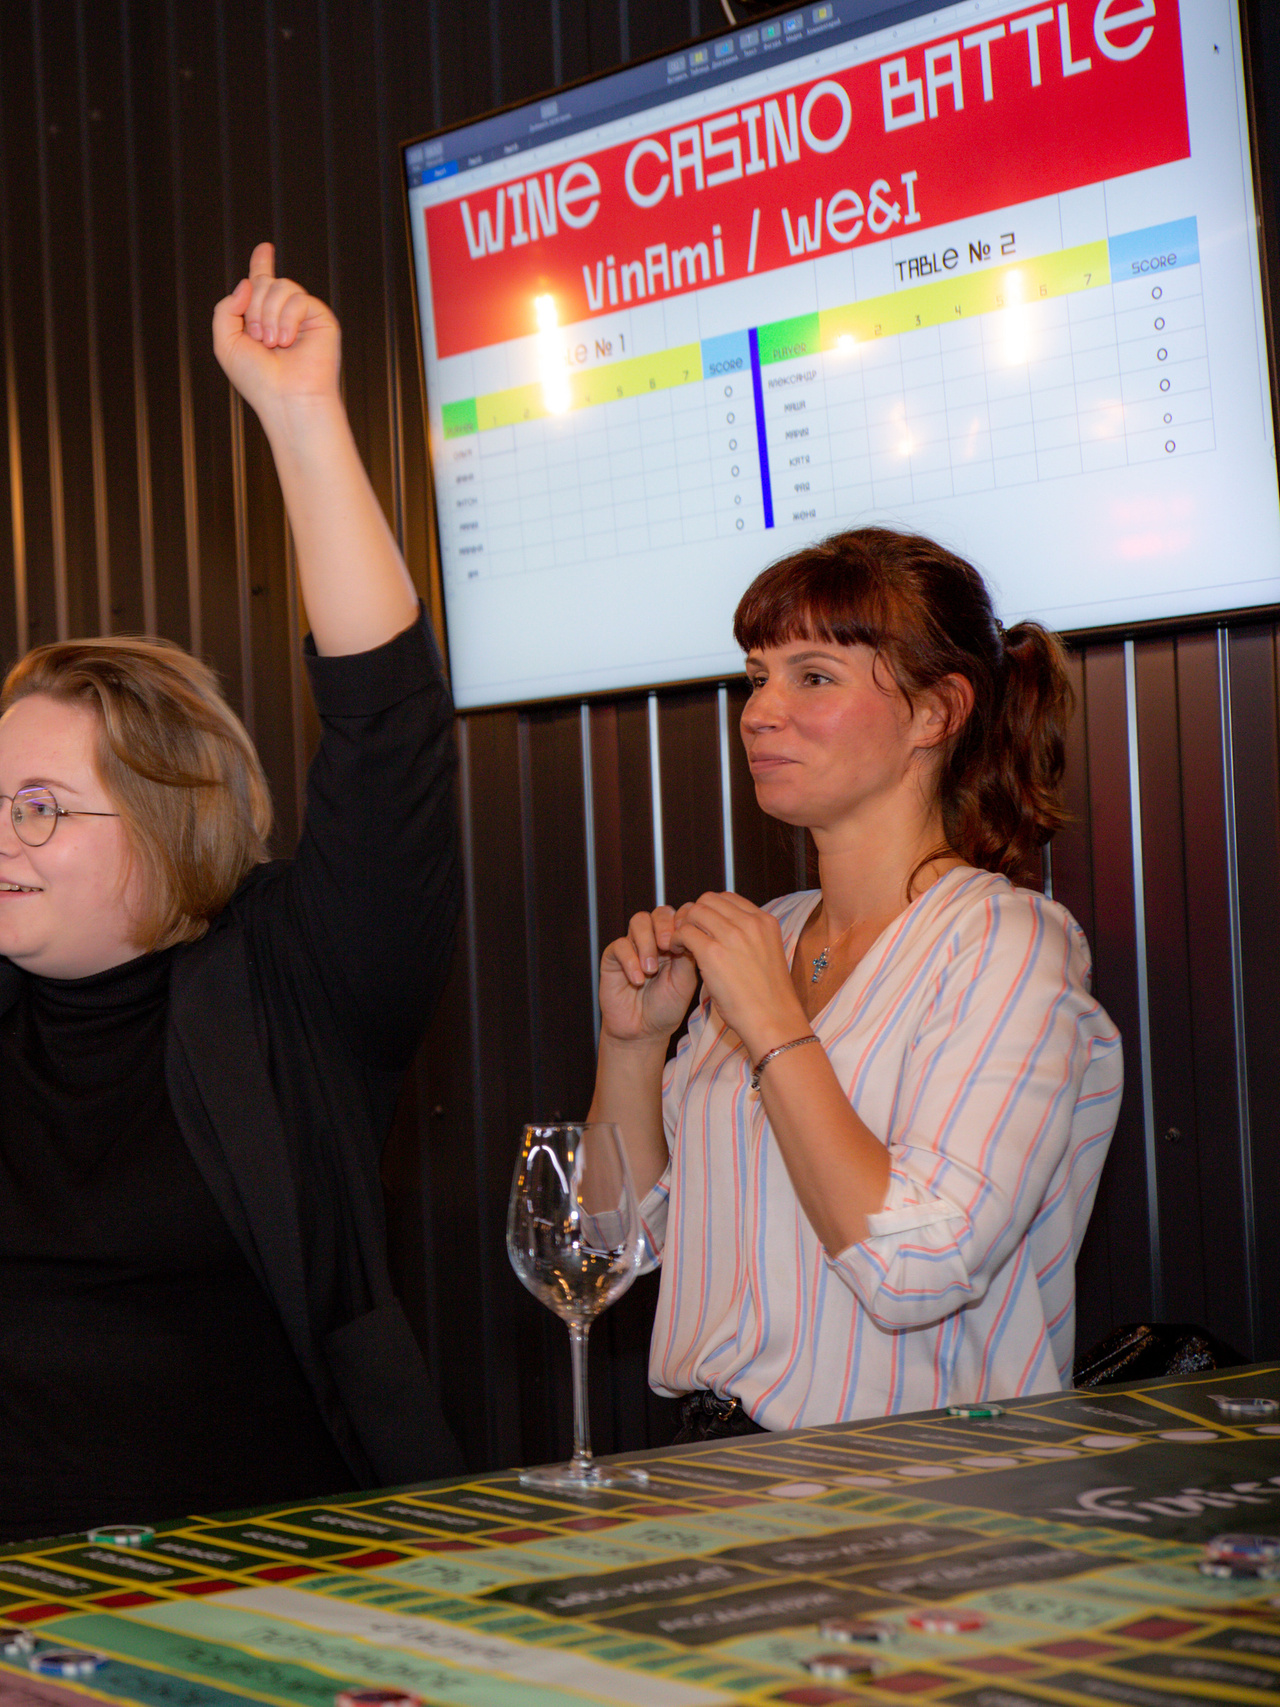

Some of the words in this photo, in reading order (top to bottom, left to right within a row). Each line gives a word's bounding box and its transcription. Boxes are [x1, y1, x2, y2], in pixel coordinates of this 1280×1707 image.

[625, 80, 852, 208] CASINO
[582, 224, 726, 311] VinAmi
[747, 208, 761, 272] /
[1000, 232, 1016, 256] 2
[914, 314, 922, 327] 3
[954, 304, 962, 317] 4
[1038, 284, 1048, 297] 6
[1083, 273, 1093, 286] 7
[618, 333, 625, 353] 1
[1045, 1475, 1280, 1523] Vini
